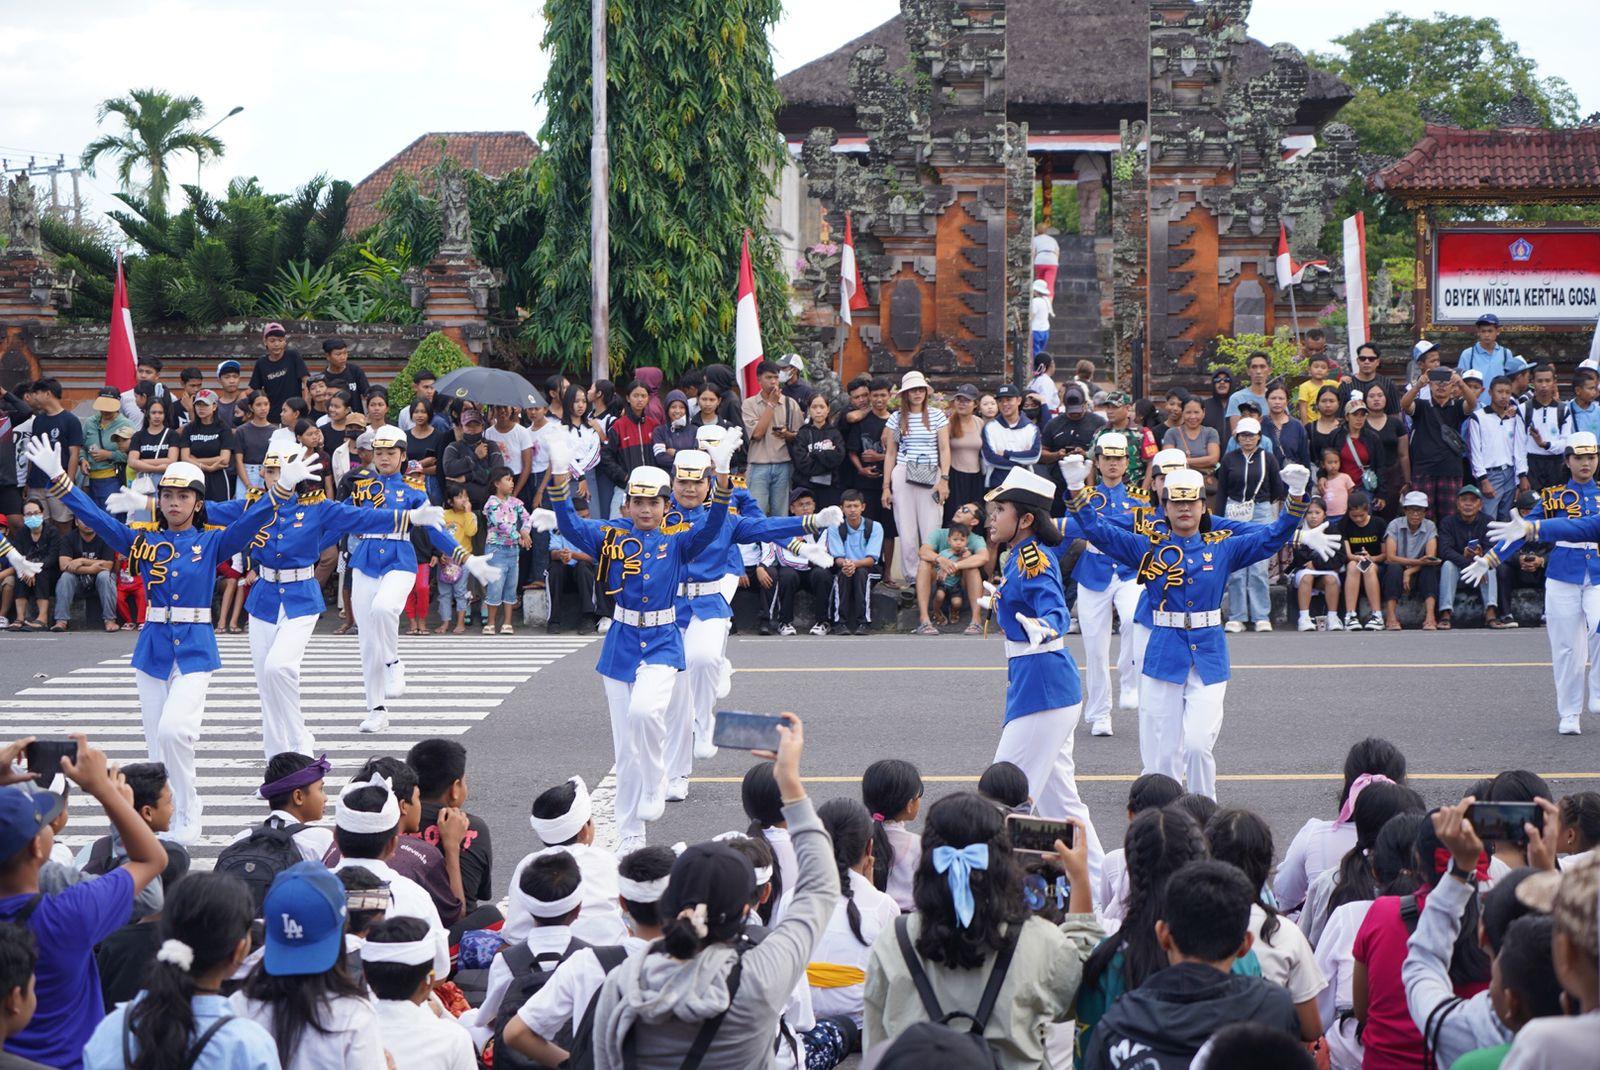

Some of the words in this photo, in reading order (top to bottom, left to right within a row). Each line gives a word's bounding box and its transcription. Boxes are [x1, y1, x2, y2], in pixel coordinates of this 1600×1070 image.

[1444, 288, 1480, 307] OBYEK
[1483, 288, 1521, 307] WISATA
[1524, 287, 1566, 306] KERTHA
[1568, 287, 1597, 306] GOSA
[281, 912, 304, 939] LA
